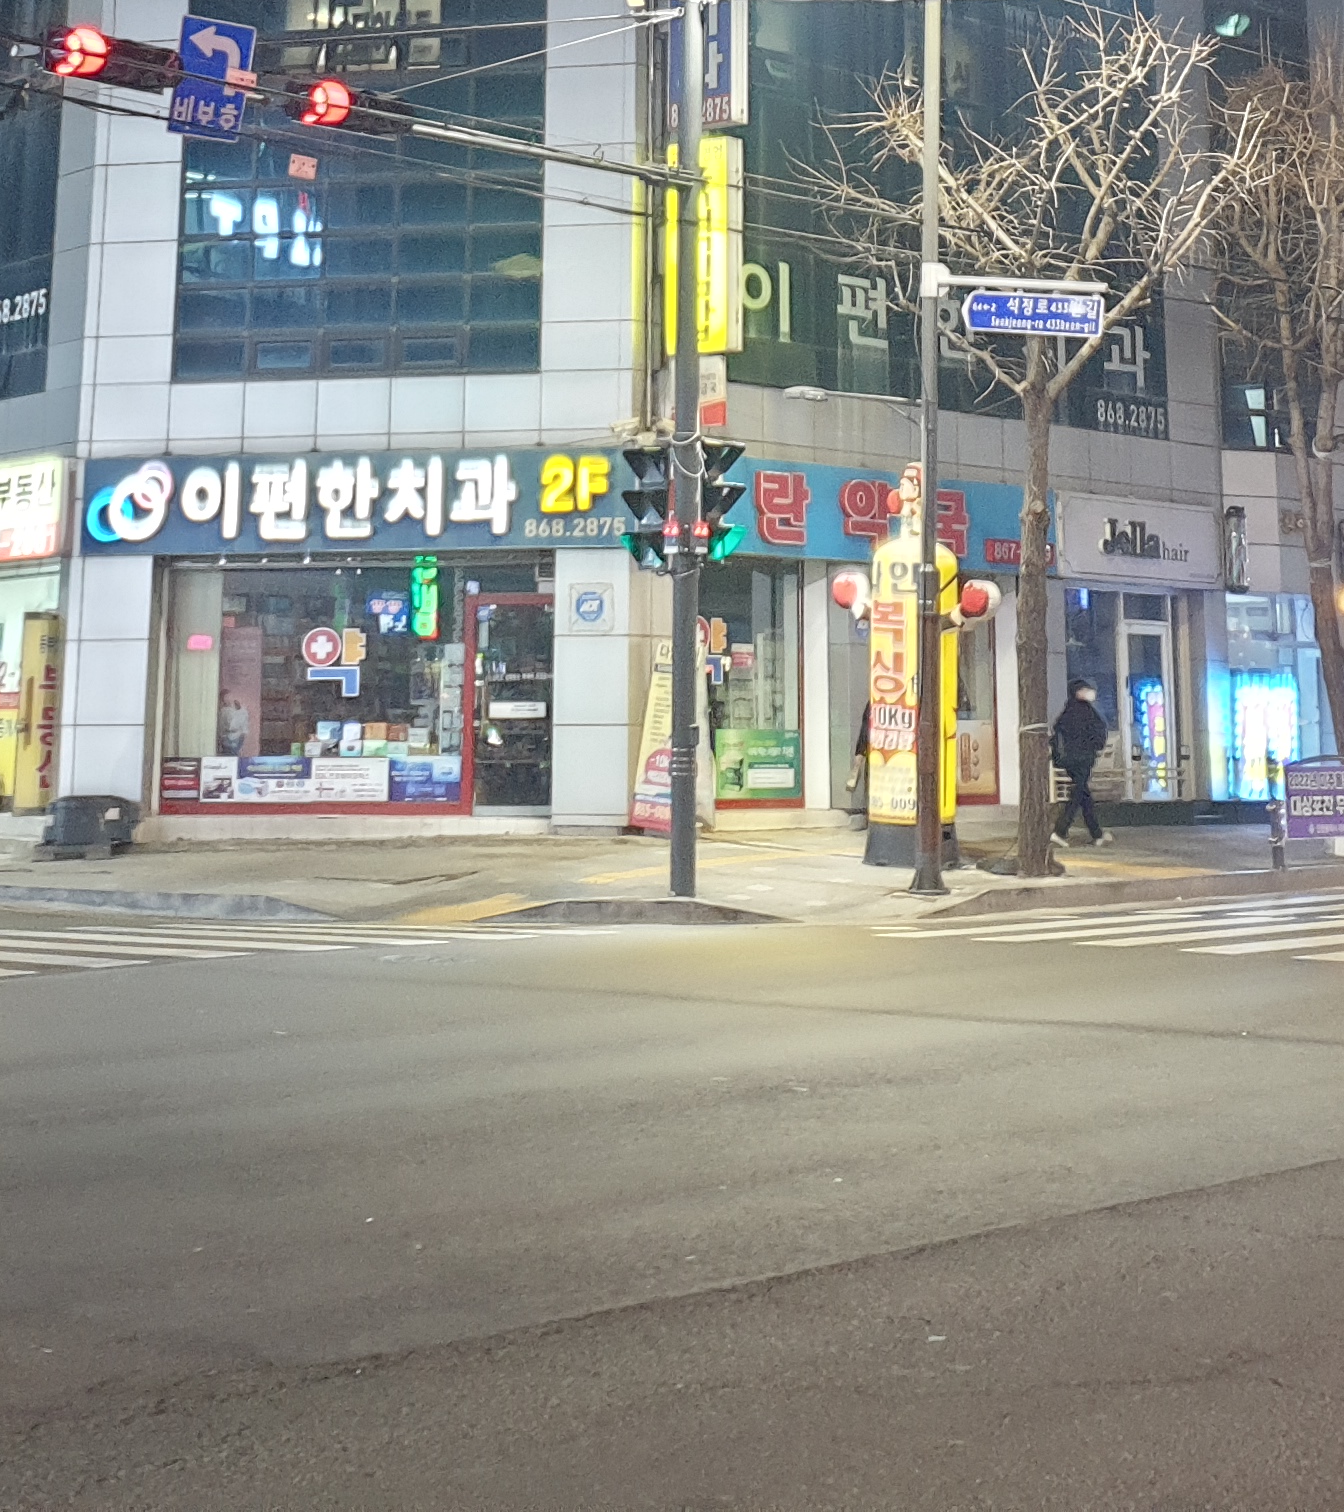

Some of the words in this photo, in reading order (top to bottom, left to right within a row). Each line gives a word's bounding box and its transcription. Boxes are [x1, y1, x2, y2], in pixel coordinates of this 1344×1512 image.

[173, 95, 240, 131] 비보호
[1096, 399, 1166, 431] 868.2875
[179, 454, 520, 542] 이편한치과
[539, 453, 612, 514] 2F
[523, 516, 627, 539] 868.2875
[1162, 540, 1190, 563] hair
[872, 600, 906, 702] 복싱
